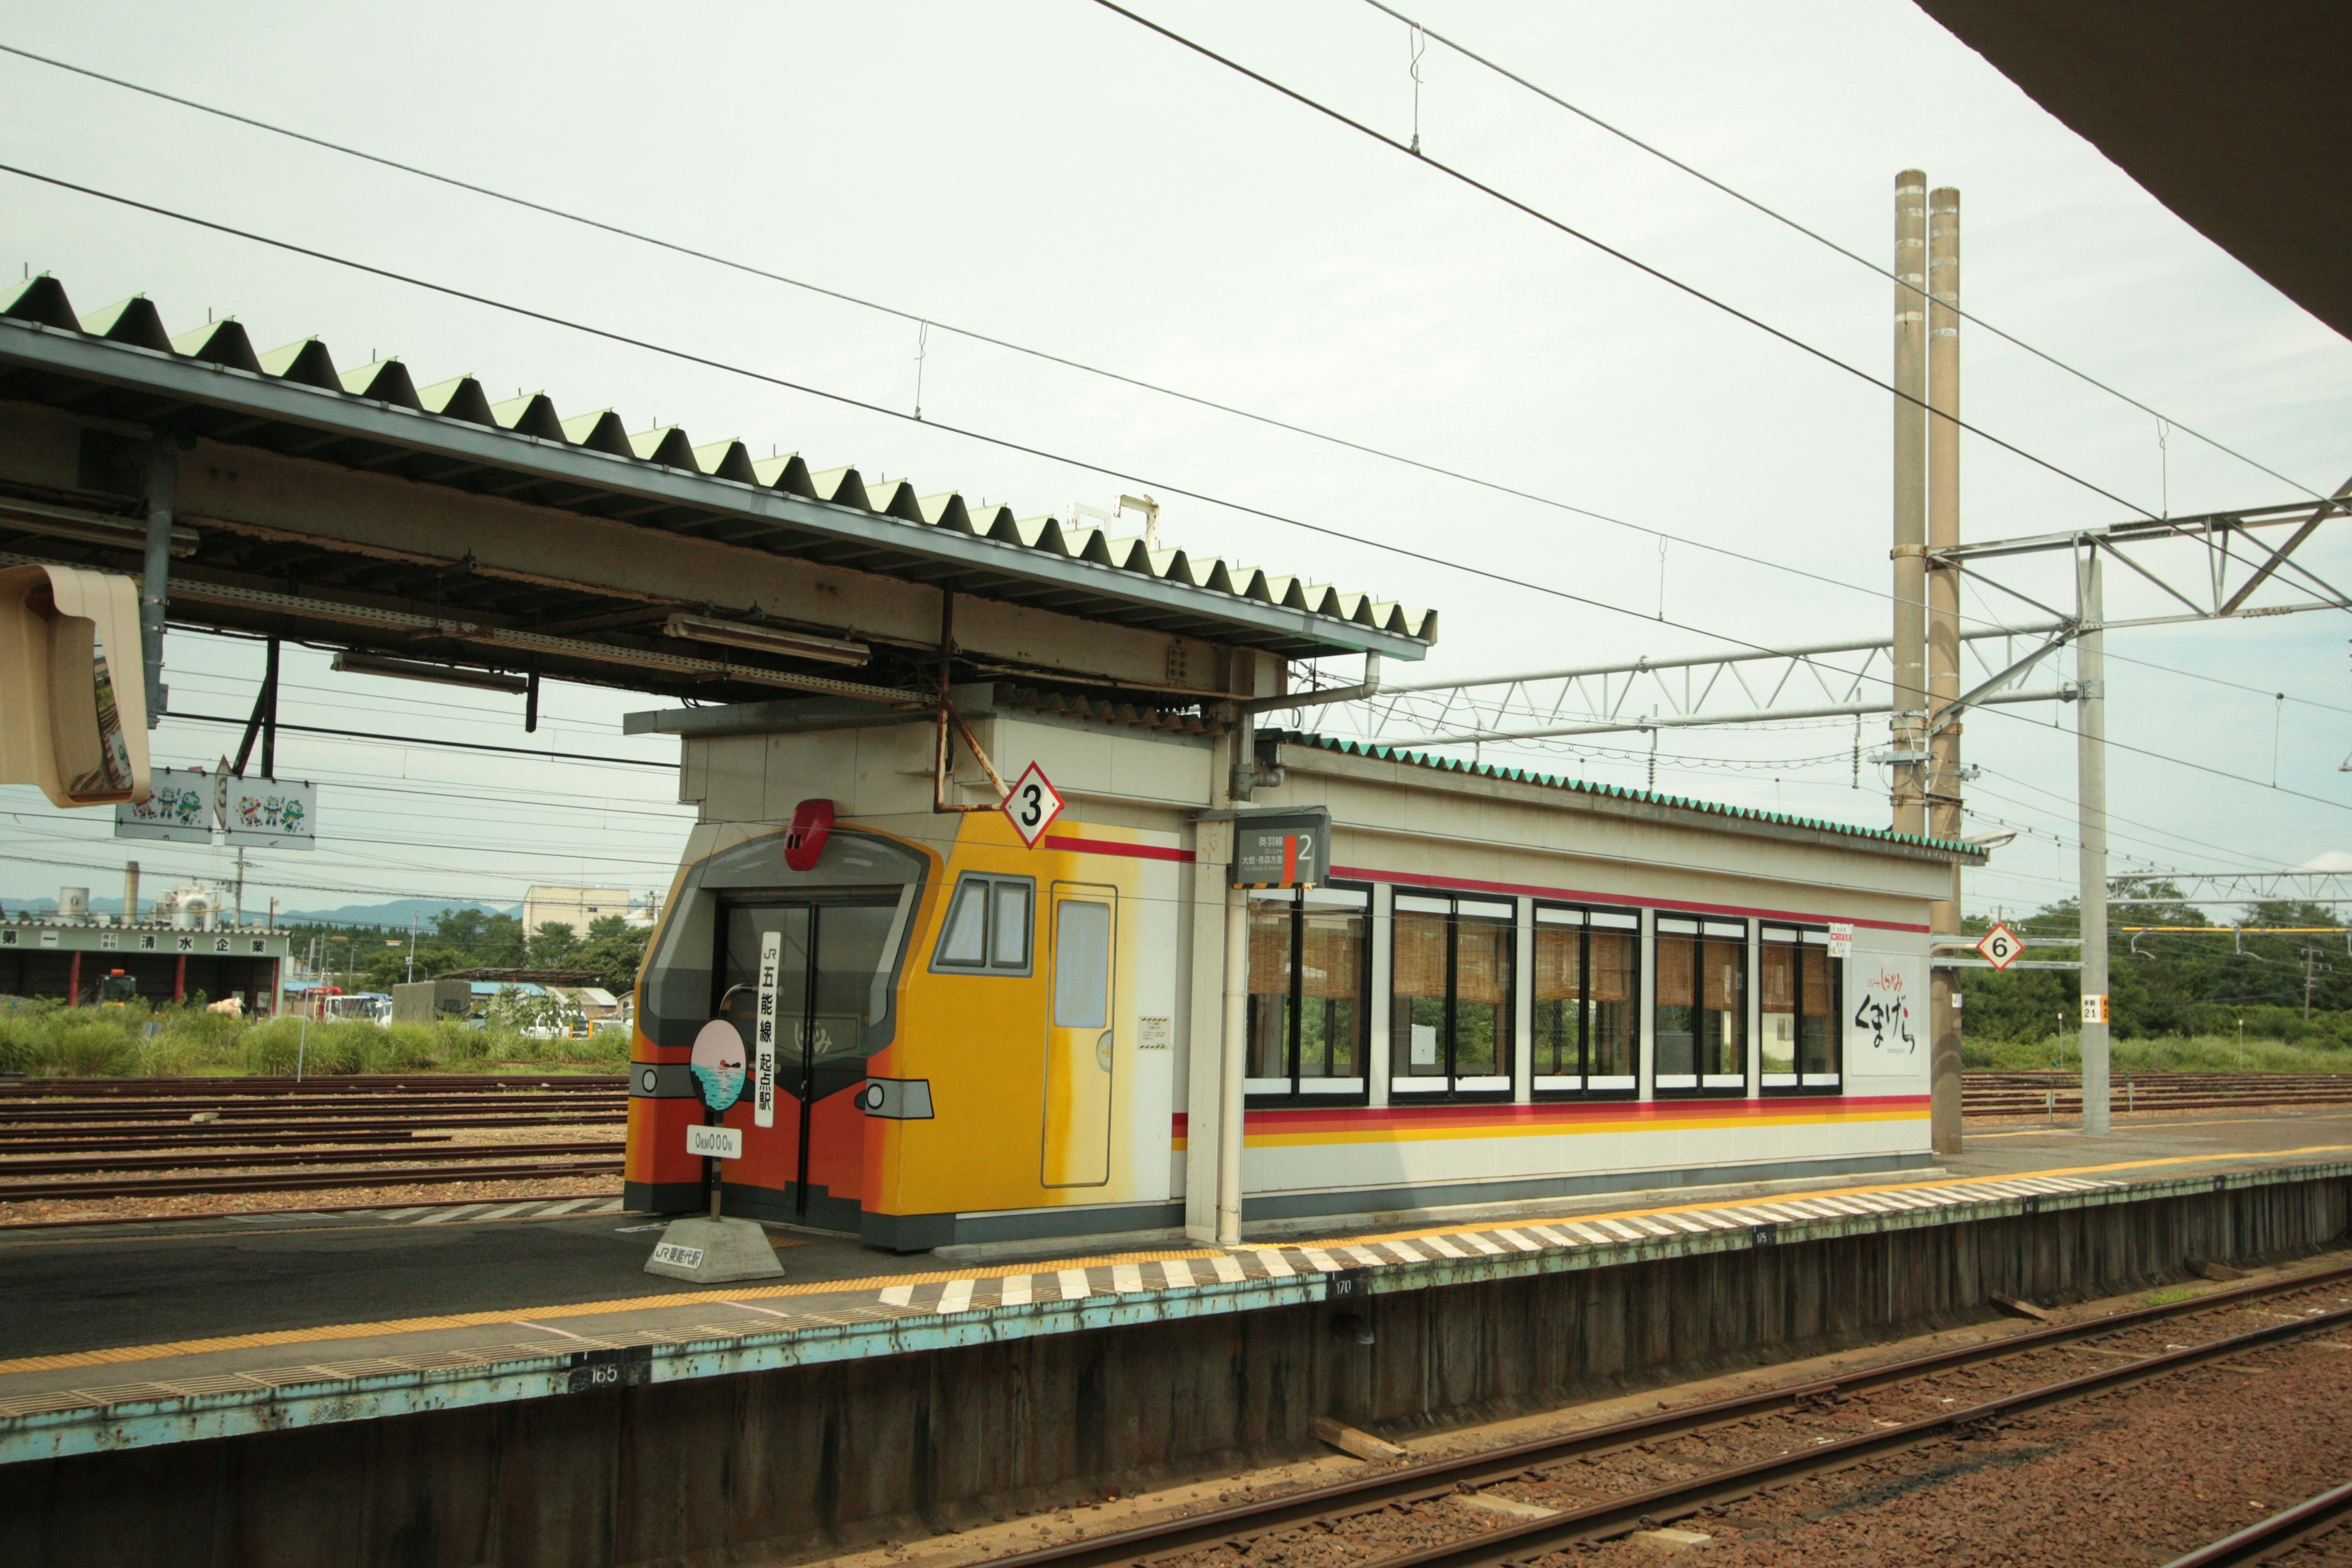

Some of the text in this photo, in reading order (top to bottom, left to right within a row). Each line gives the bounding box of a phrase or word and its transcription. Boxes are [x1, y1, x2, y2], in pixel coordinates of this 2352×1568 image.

[1021, 784, 1042, 827] 3
[1259, 836, 1284, 847] 奥羽線
[1298, 834, 1312, 860] 2
[141, 935, 265, 953] 清水企業
[1992, 937, 2007, 957] 6
[2084, 1008, 2095, 1017] 21
[758, 949, 777, 1111] JR 五能線 起点駅
[1757, 1232, 1766, 1243] 175
[1336, 1280, 1351, 1295] 170
[592, 1365, 617, 1383] 165
